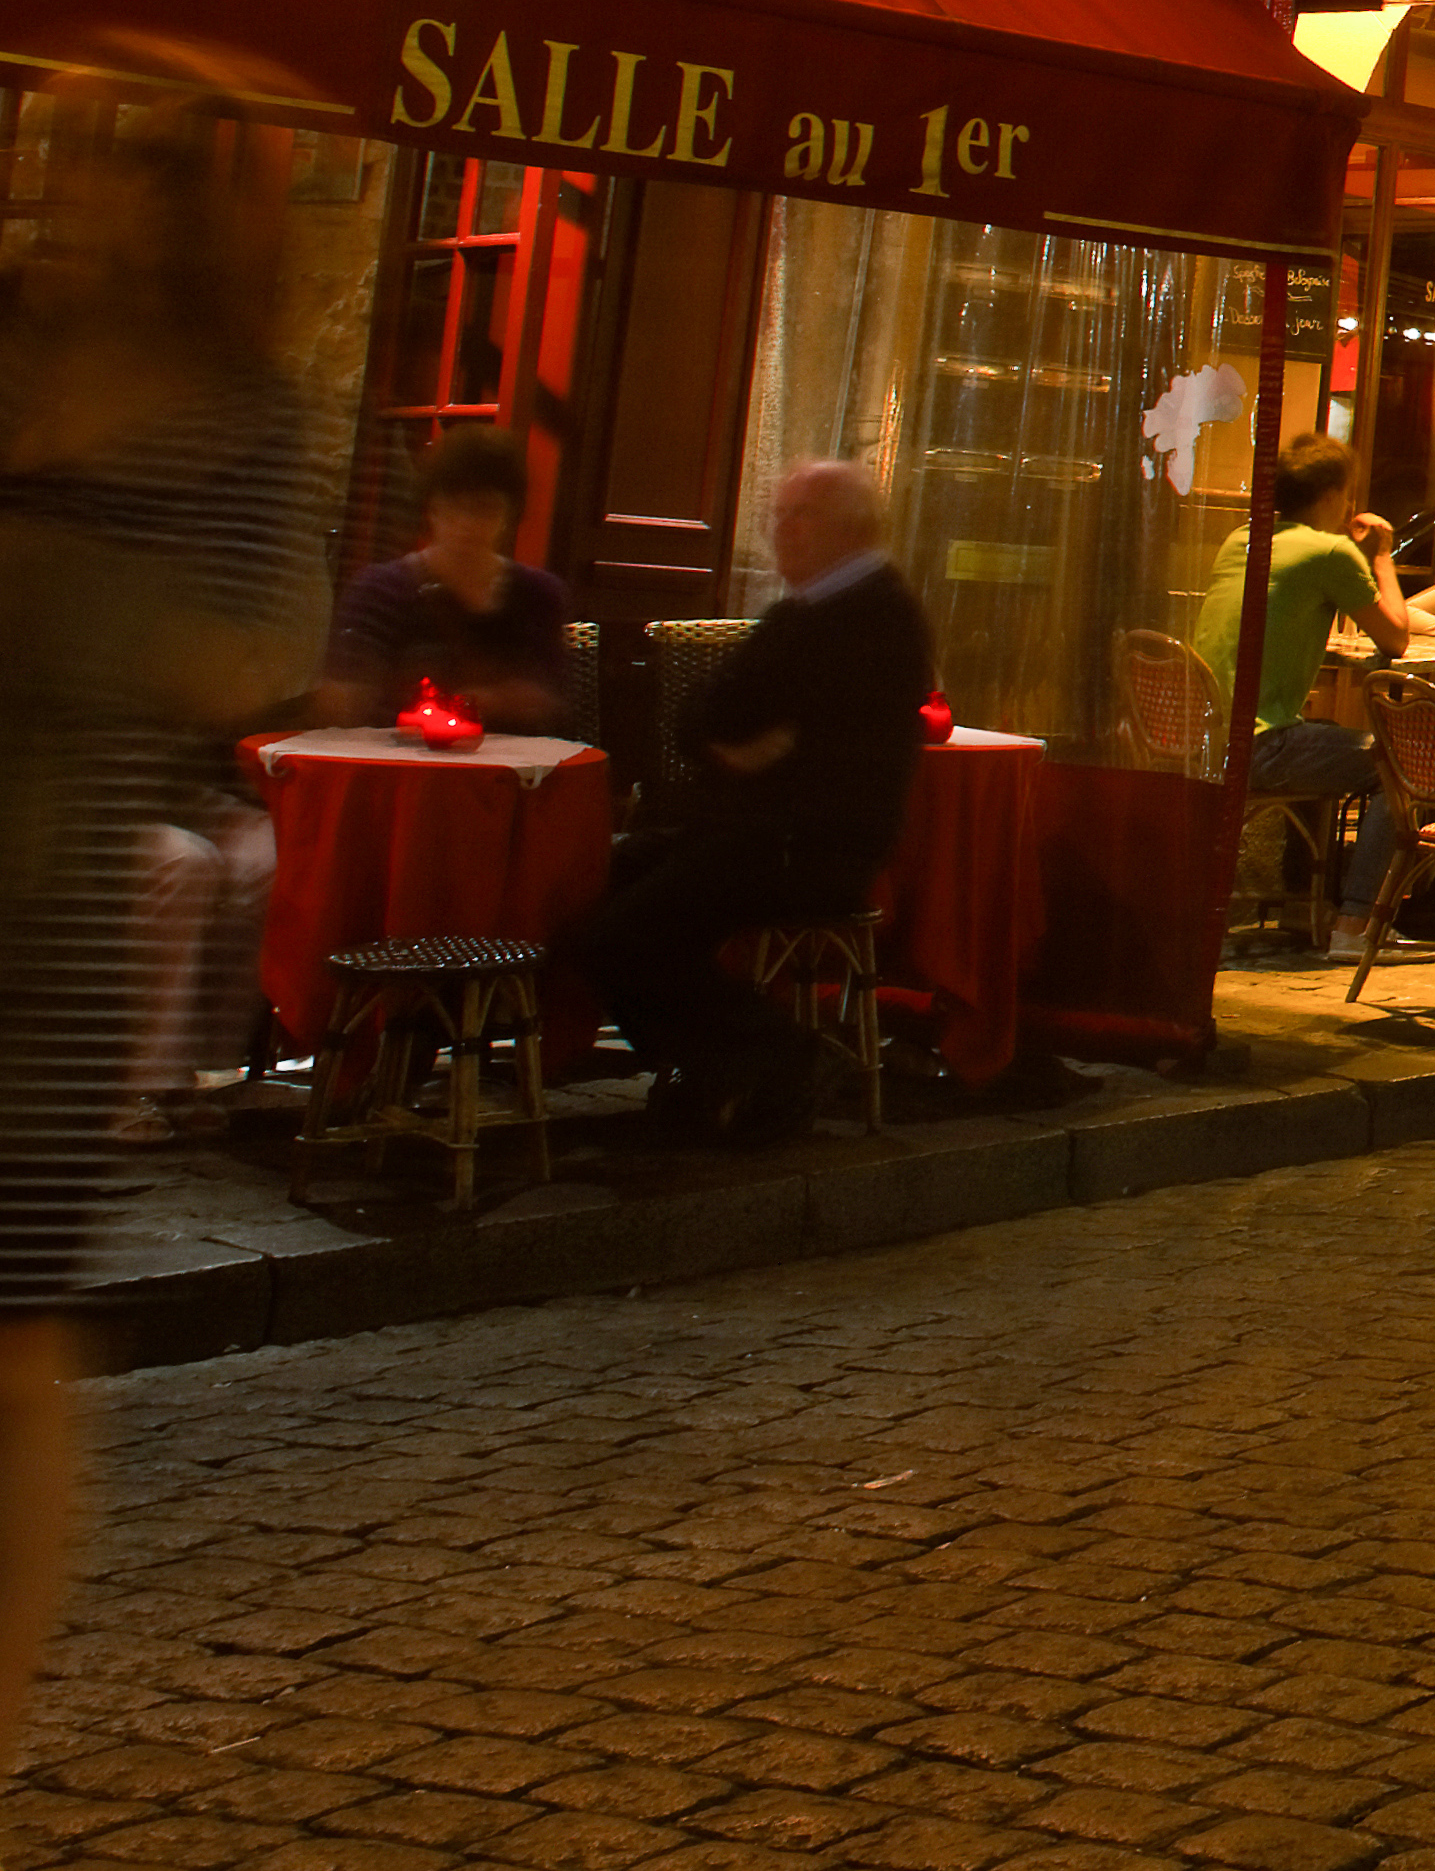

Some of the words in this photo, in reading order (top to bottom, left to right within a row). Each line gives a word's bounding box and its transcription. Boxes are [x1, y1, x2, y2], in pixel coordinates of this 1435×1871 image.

[390, 16, 736, 171] SALLE
[783, 105, 874, 189] au
[908, 102, 1032, 199] 1er
